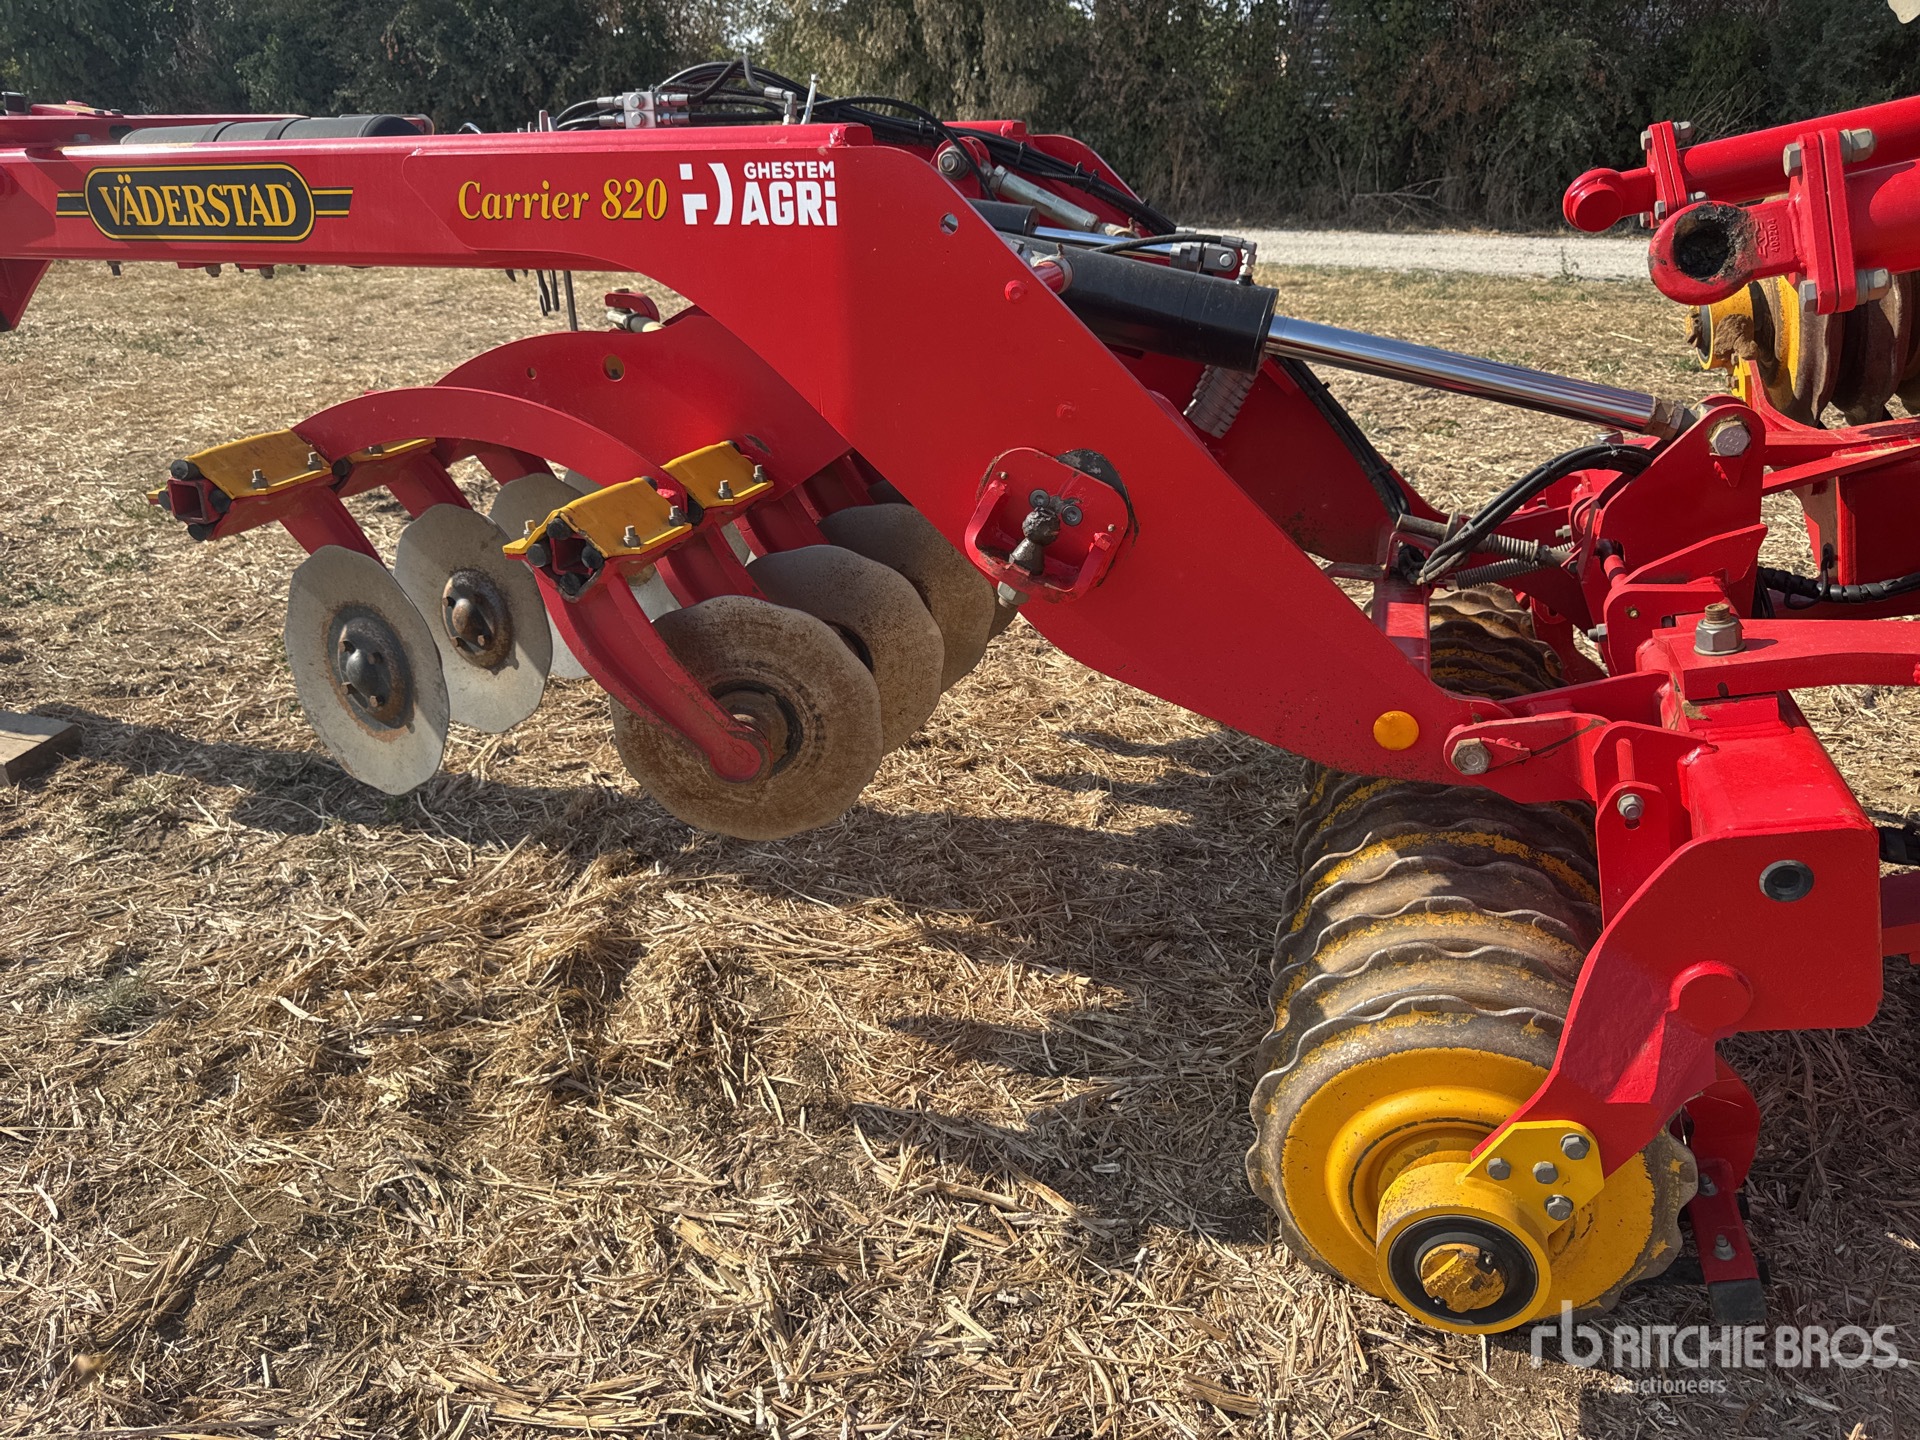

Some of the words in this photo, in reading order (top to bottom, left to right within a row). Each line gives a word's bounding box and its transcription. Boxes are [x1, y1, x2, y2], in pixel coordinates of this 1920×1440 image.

[744, 161, 835, 179] GHESTEM
[98, 174, 297, 226] VÄDERSTAD
[458, 180, 590, 221] Carrier
[600, 178, 668, 221] 820
